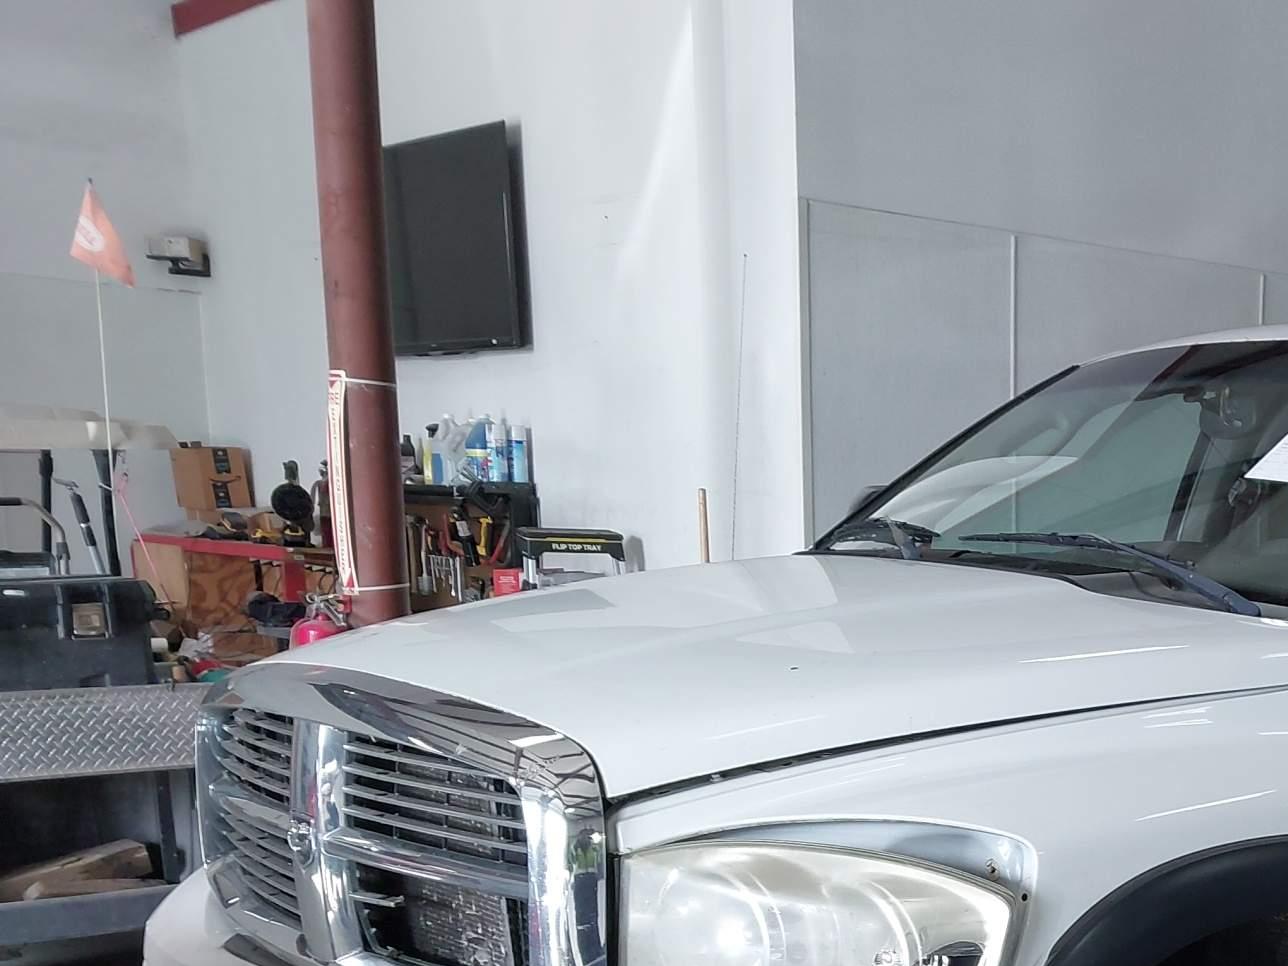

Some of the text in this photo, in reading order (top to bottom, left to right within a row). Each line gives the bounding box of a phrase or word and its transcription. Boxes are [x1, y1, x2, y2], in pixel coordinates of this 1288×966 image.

[552, 542, 601, 552] FLIP TOP TRAY
